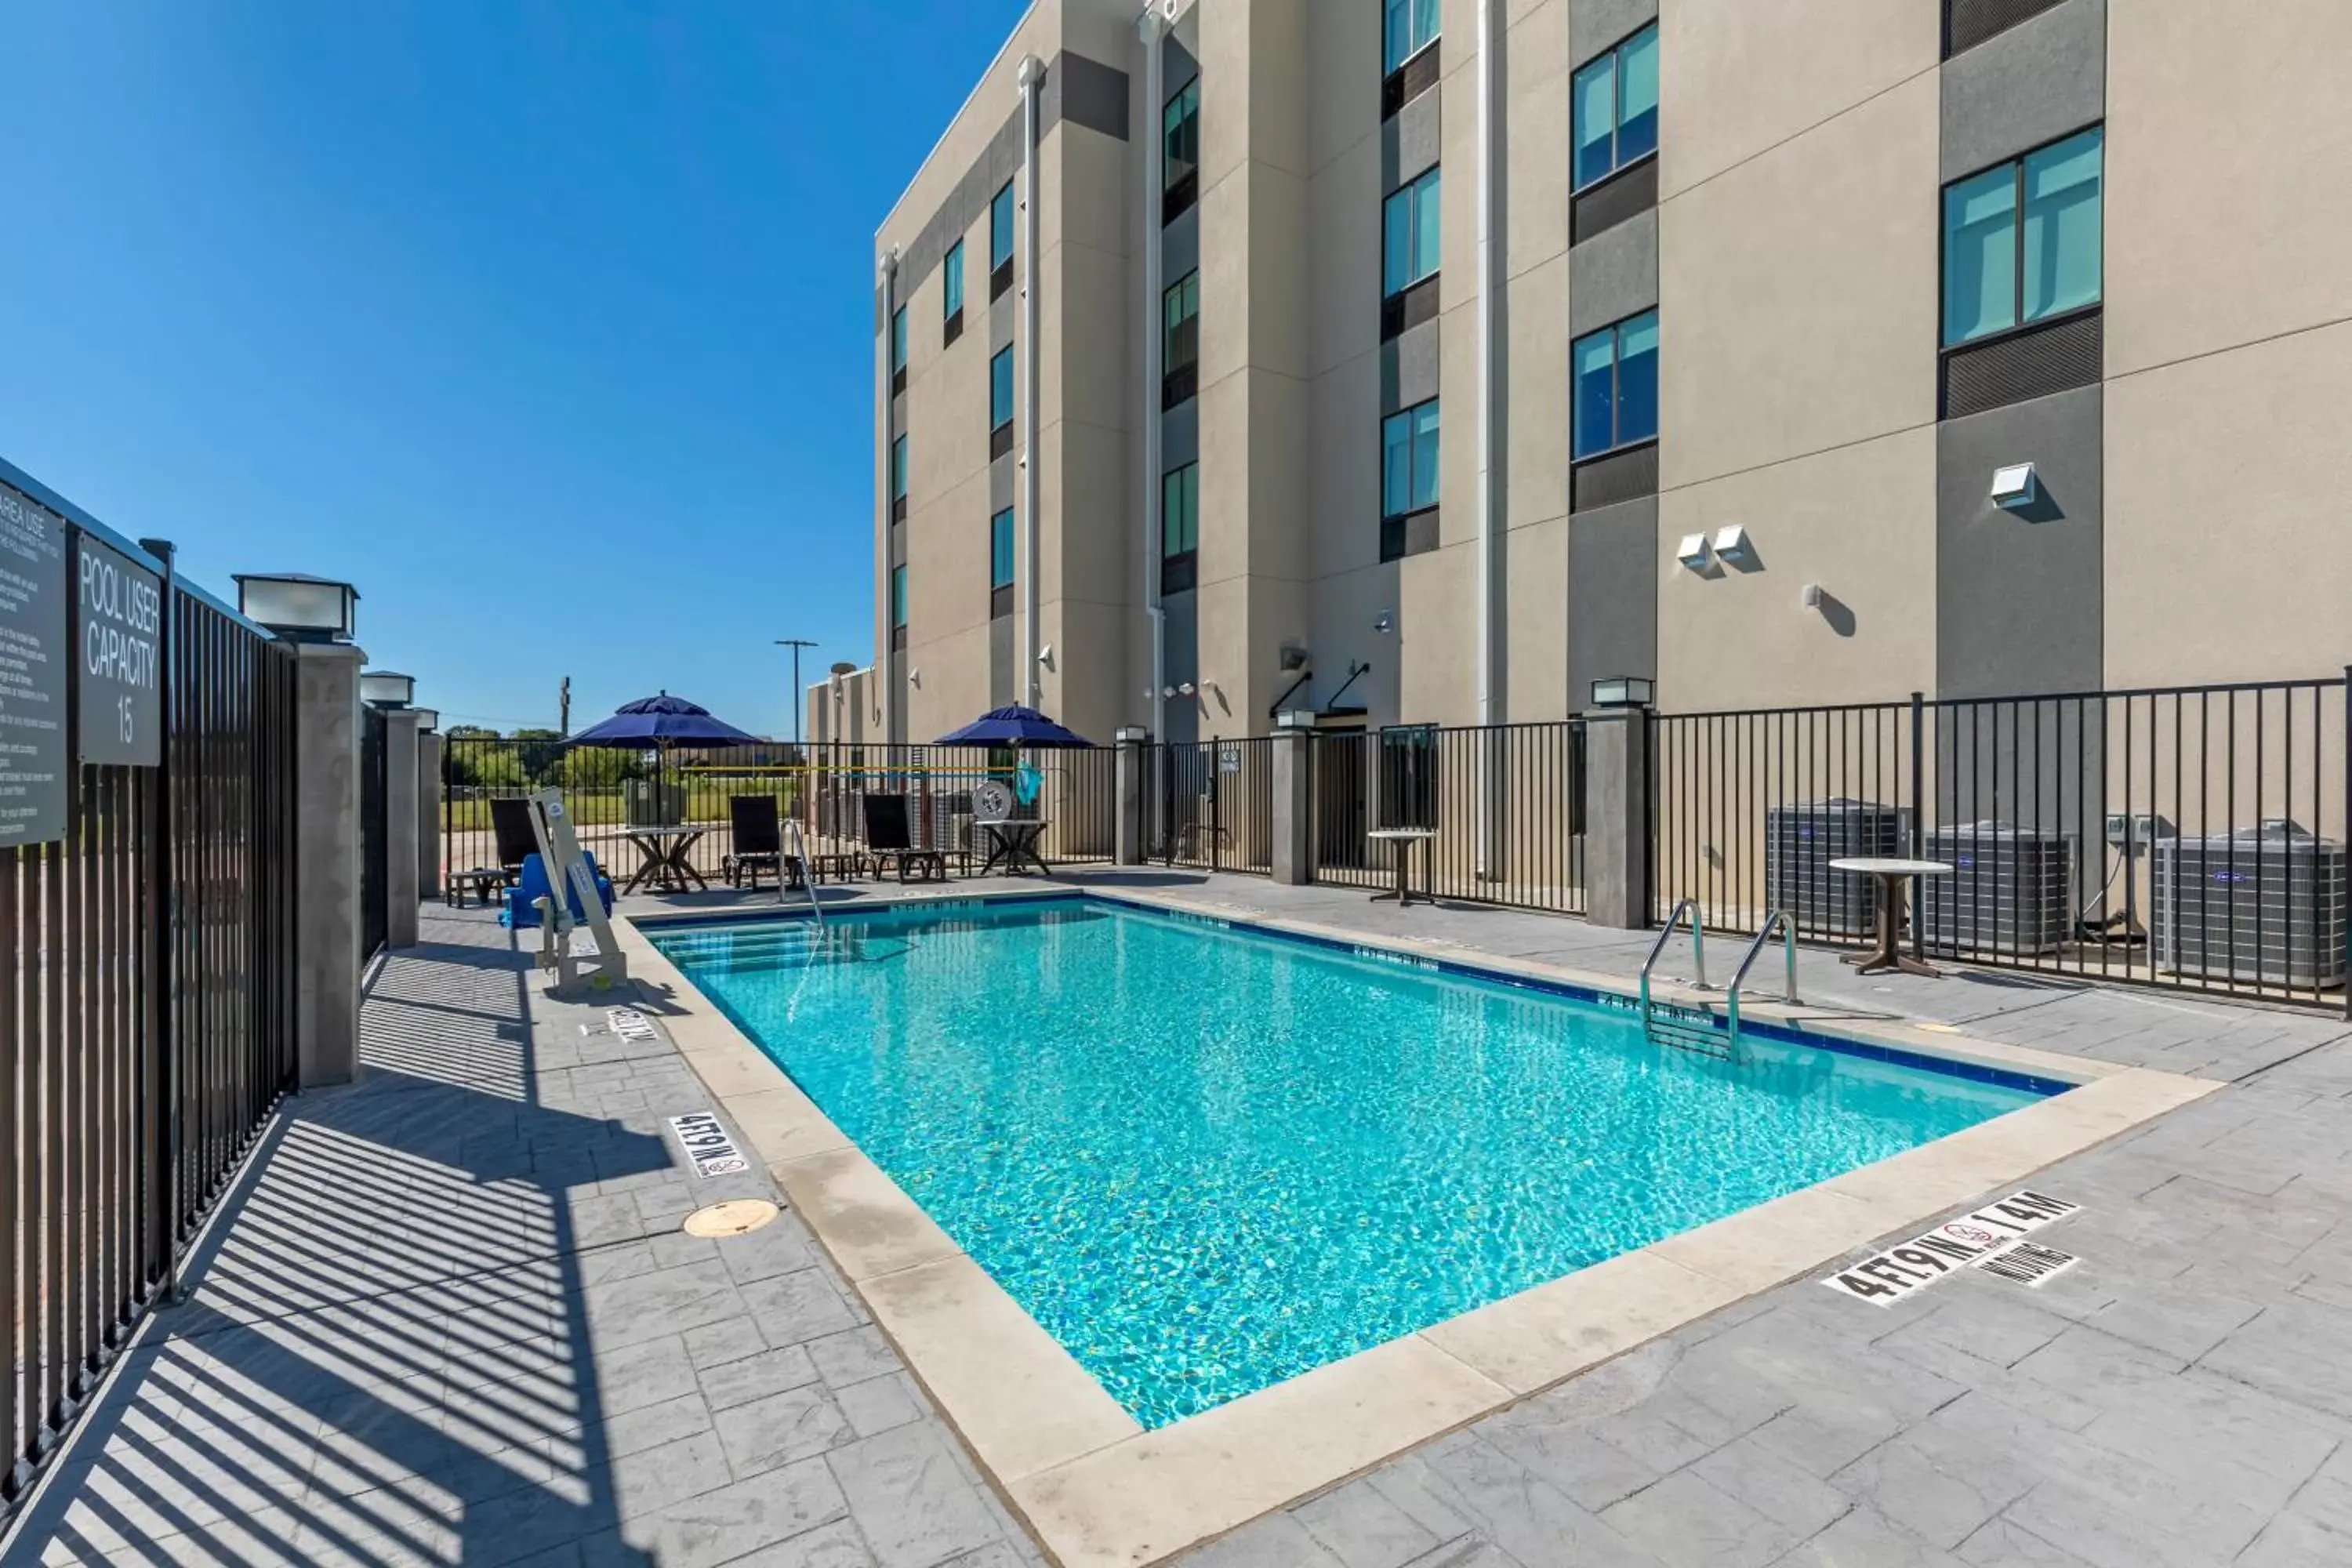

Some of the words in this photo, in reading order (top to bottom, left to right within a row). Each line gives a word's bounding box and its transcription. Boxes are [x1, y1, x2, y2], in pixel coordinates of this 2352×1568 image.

[26, 509, 45, 539] USE
[81, 552, 122, 620] POOL
[126, 576, 159, 637] USER
[87, 621, 155, 690] CAPACITY
[118, 694, 133, 744] 15
